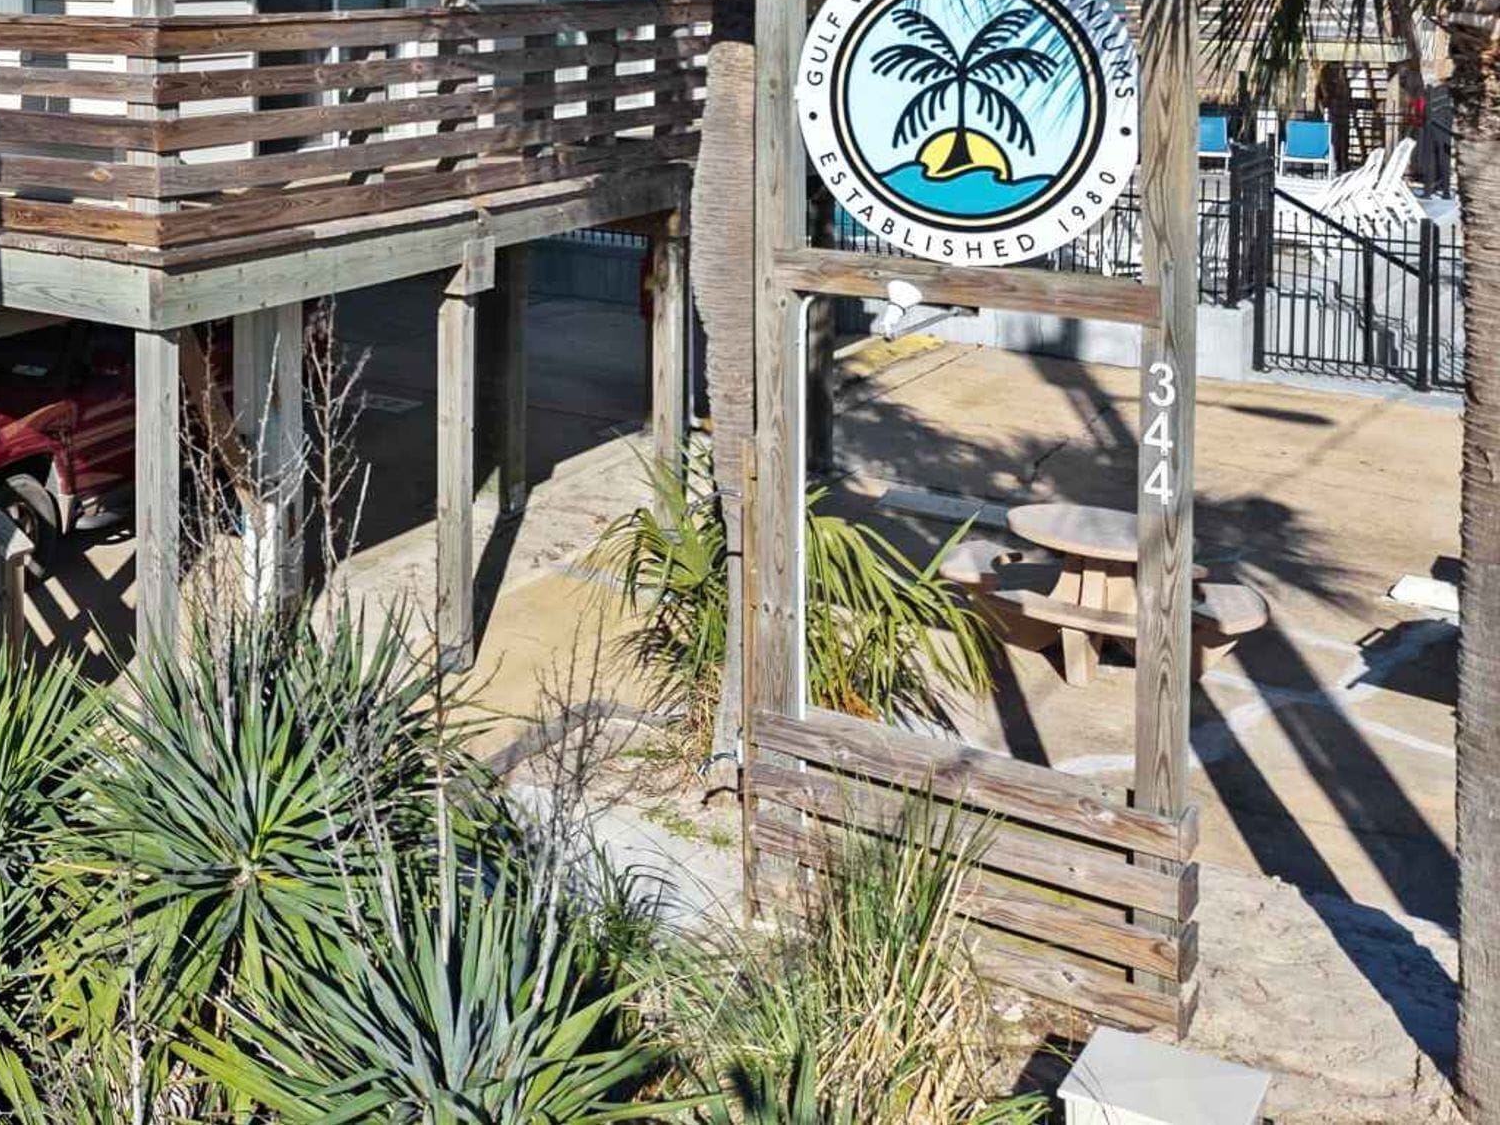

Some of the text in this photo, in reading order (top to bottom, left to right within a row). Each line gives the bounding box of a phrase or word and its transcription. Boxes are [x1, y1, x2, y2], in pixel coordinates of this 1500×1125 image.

[808, 12, 841, 86] GULF
[820, 153, 1117, 260] ESTABLISHED 1980
[1143, 362, 1176, 506] 344
